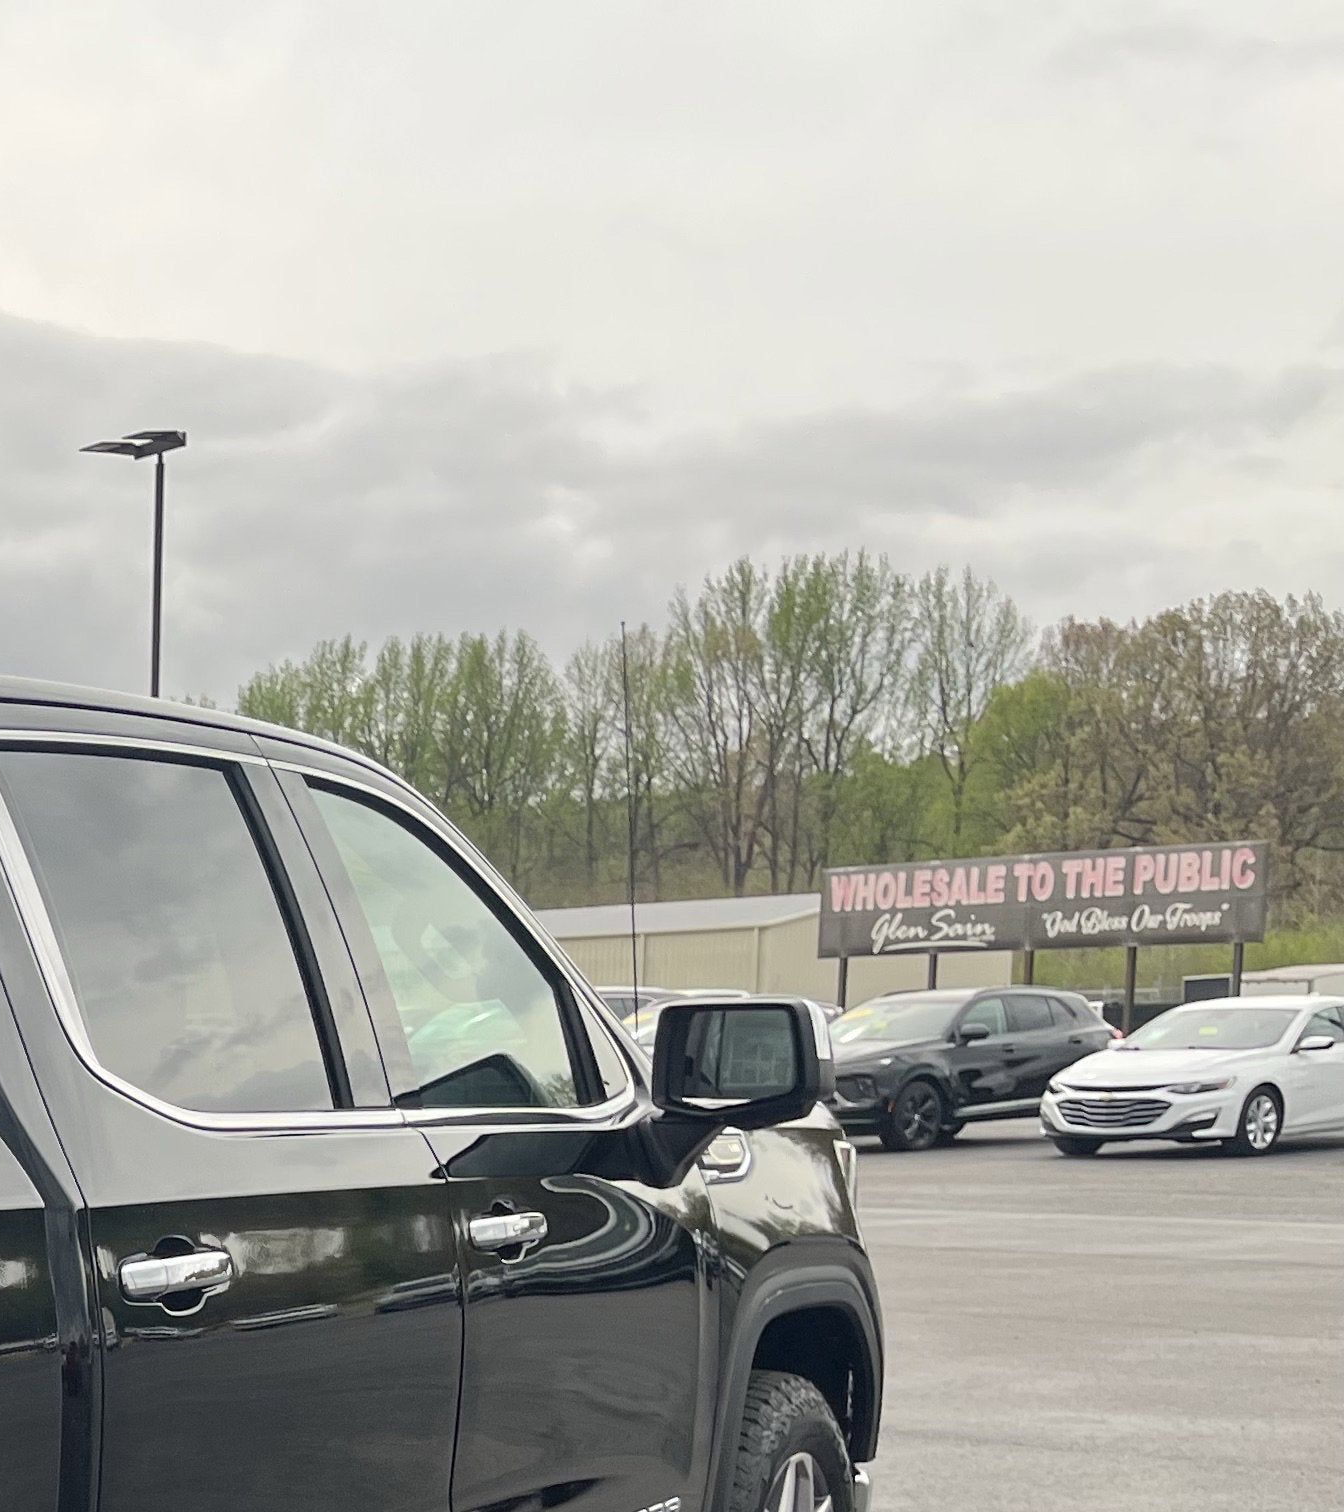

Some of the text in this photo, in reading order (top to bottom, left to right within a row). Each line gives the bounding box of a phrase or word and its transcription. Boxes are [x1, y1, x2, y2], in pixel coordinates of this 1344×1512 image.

[831, 848, 1257, 912] WHOLESALE TO THE PUBLIC
[871, 908, 996, 954] Glen Sain
